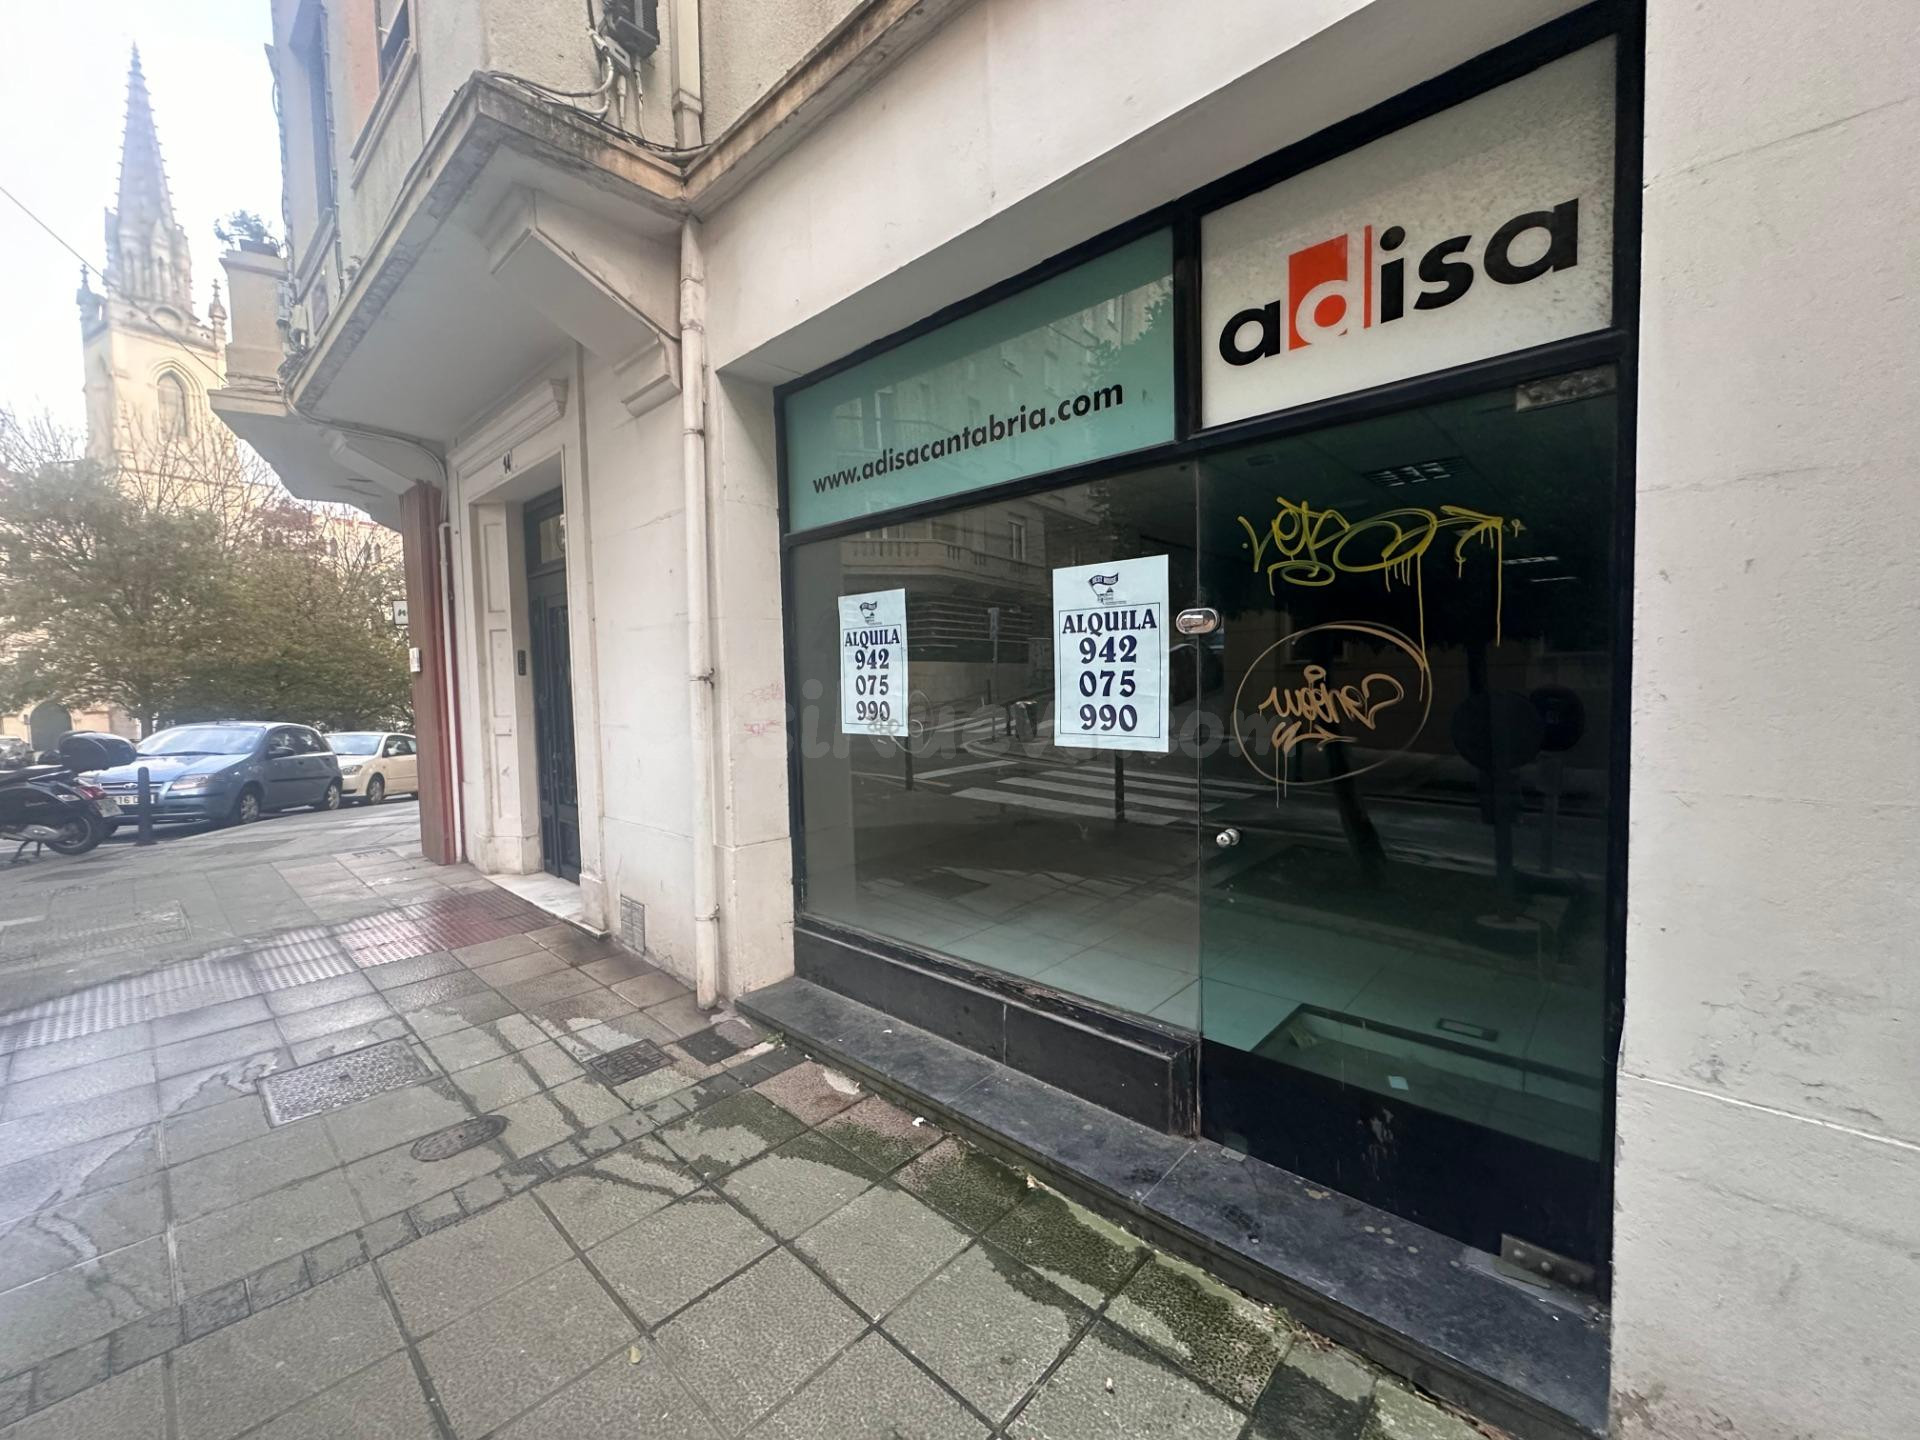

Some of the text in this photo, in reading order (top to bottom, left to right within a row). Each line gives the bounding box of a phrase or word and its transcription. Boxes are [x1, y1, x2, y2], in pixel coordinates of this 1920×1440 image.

[1218, 198, 1579, 366] adisa
[812, 383, 1124, 494] www.adisacantabria.com
[1062, 608, 1157, 637] ALQUILA
[845, 628, 900, 649] ALQUILA
[1080, 634, 1137, 664] 942
[855, 648, 889, 670] 942
[856, 674, 889, 696] 075
[1080, 669, 1136, 697] 075
[856, 700, 890, 722] 990
[1080, 704, 1137, 732] 990
